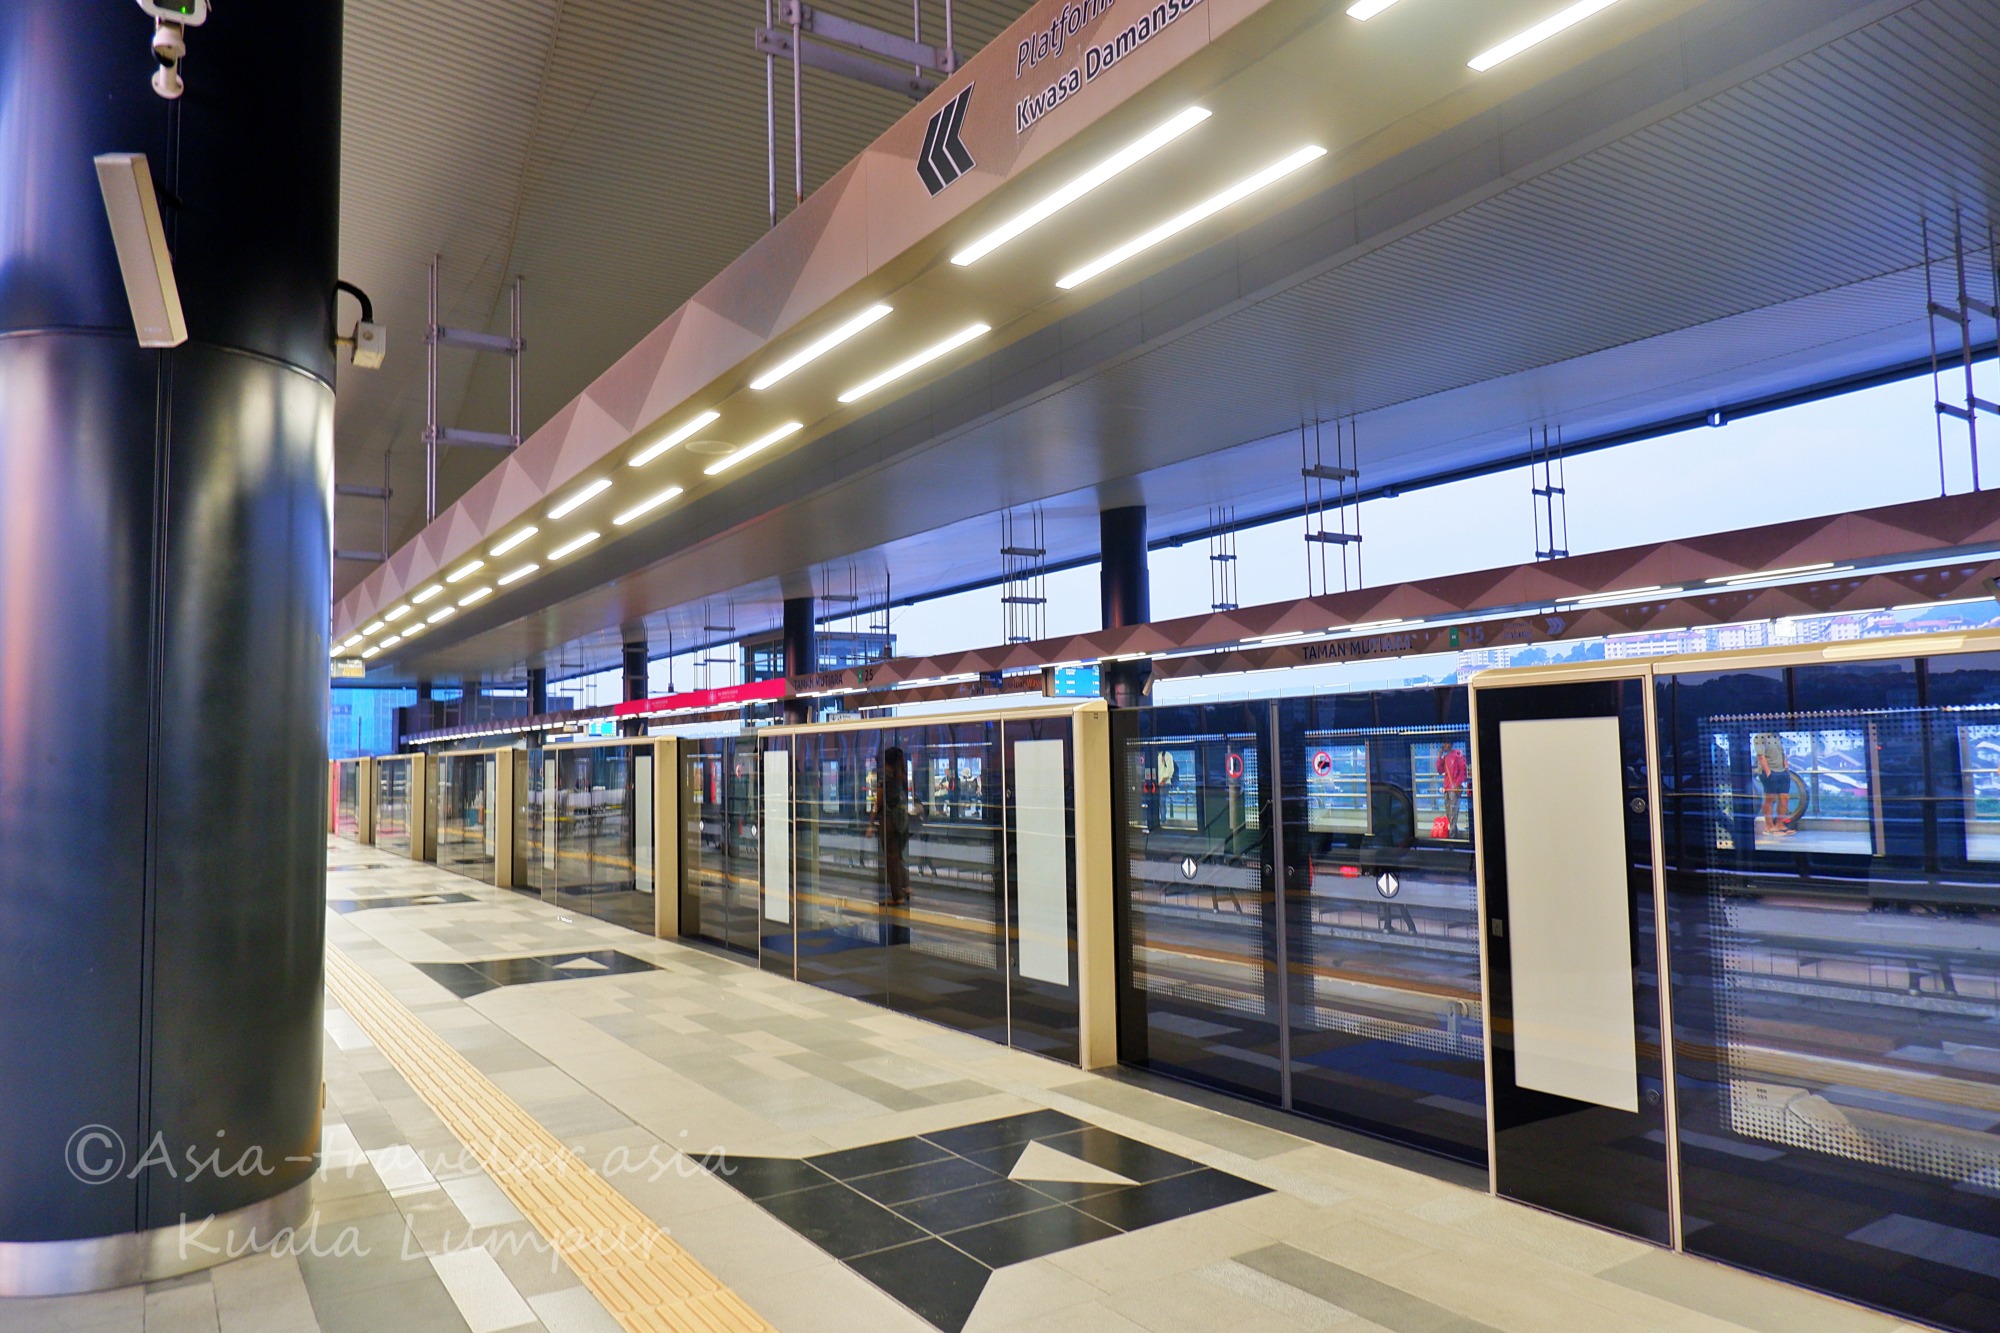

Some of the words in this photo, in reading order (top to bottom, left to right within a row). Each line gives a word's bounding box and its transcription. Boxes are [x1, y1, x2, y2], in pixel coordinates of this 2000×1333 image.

[1016, 67, 1082, 134] Kwasa
[1302, 642, 1346, 660] TAMAN
[1350, 635, 1413, 655] MUTIARA
[865, 668, 874, 681] 25
